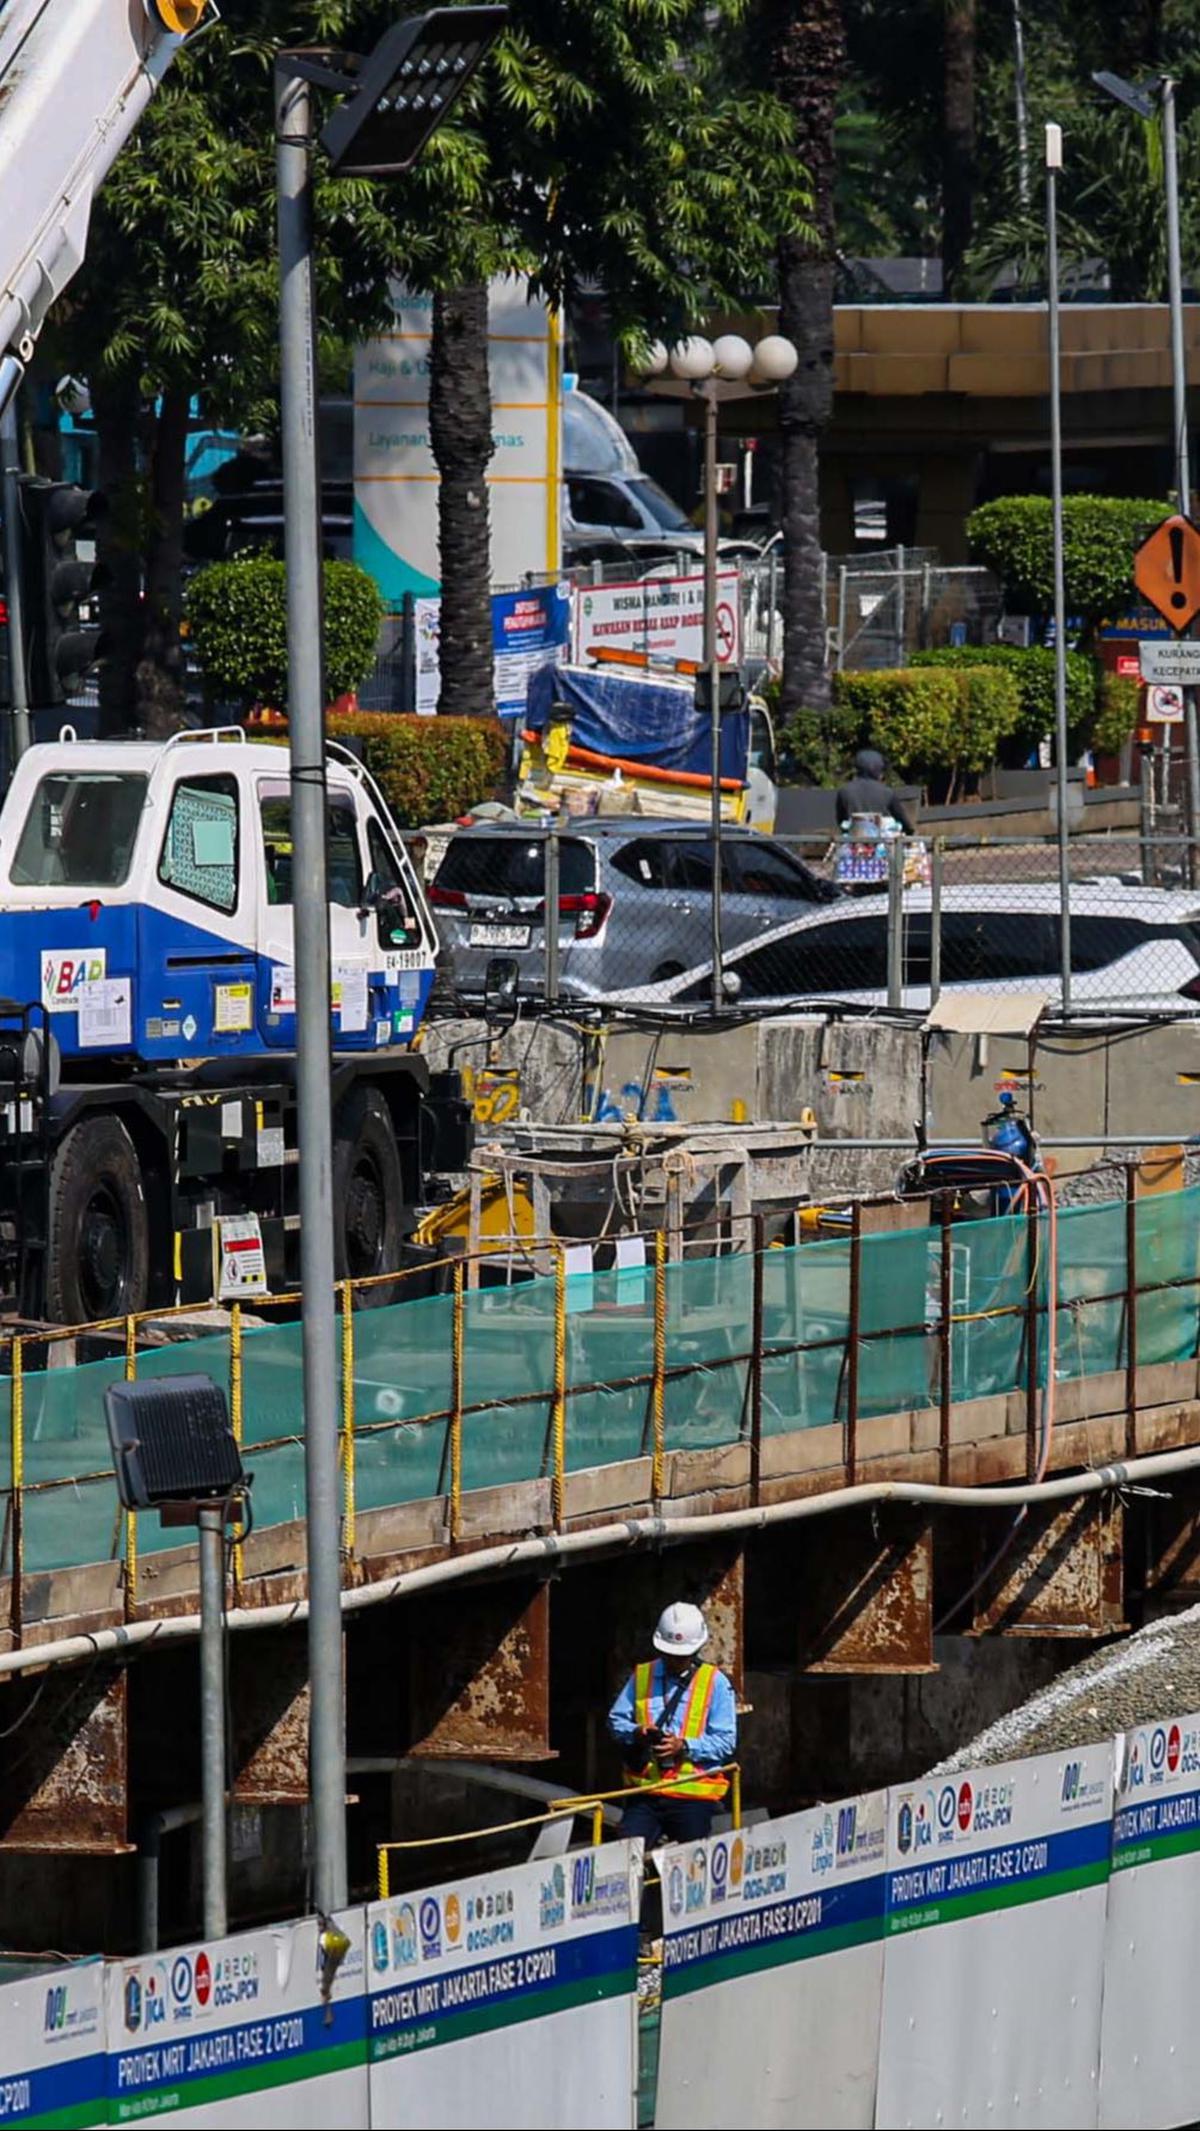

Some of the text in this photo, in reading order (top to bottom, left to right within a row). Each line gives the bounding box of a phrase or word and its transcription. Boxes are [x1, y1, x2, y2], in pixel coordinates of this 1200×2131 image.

[369, 431, 427, 449] Layanan
[1140, 1806, 1158, 1834] MRT
[1157, 1797, 1197, 1830] JAKARTA
[891, 1842, 1048, 1903] PROYEK MRT JAKARTA FASE 2 CP201
[663, 1896, 822, 1968] PROYEK MRT JAKARTA FASE 2 CP201
[372, 1948, 556, 2028] PROYEK MRT JAKARTA FASE 2 CP201
[118, 2017, 304, 2088] PROYEK MRT JAKARTA FASE 2 CP201
